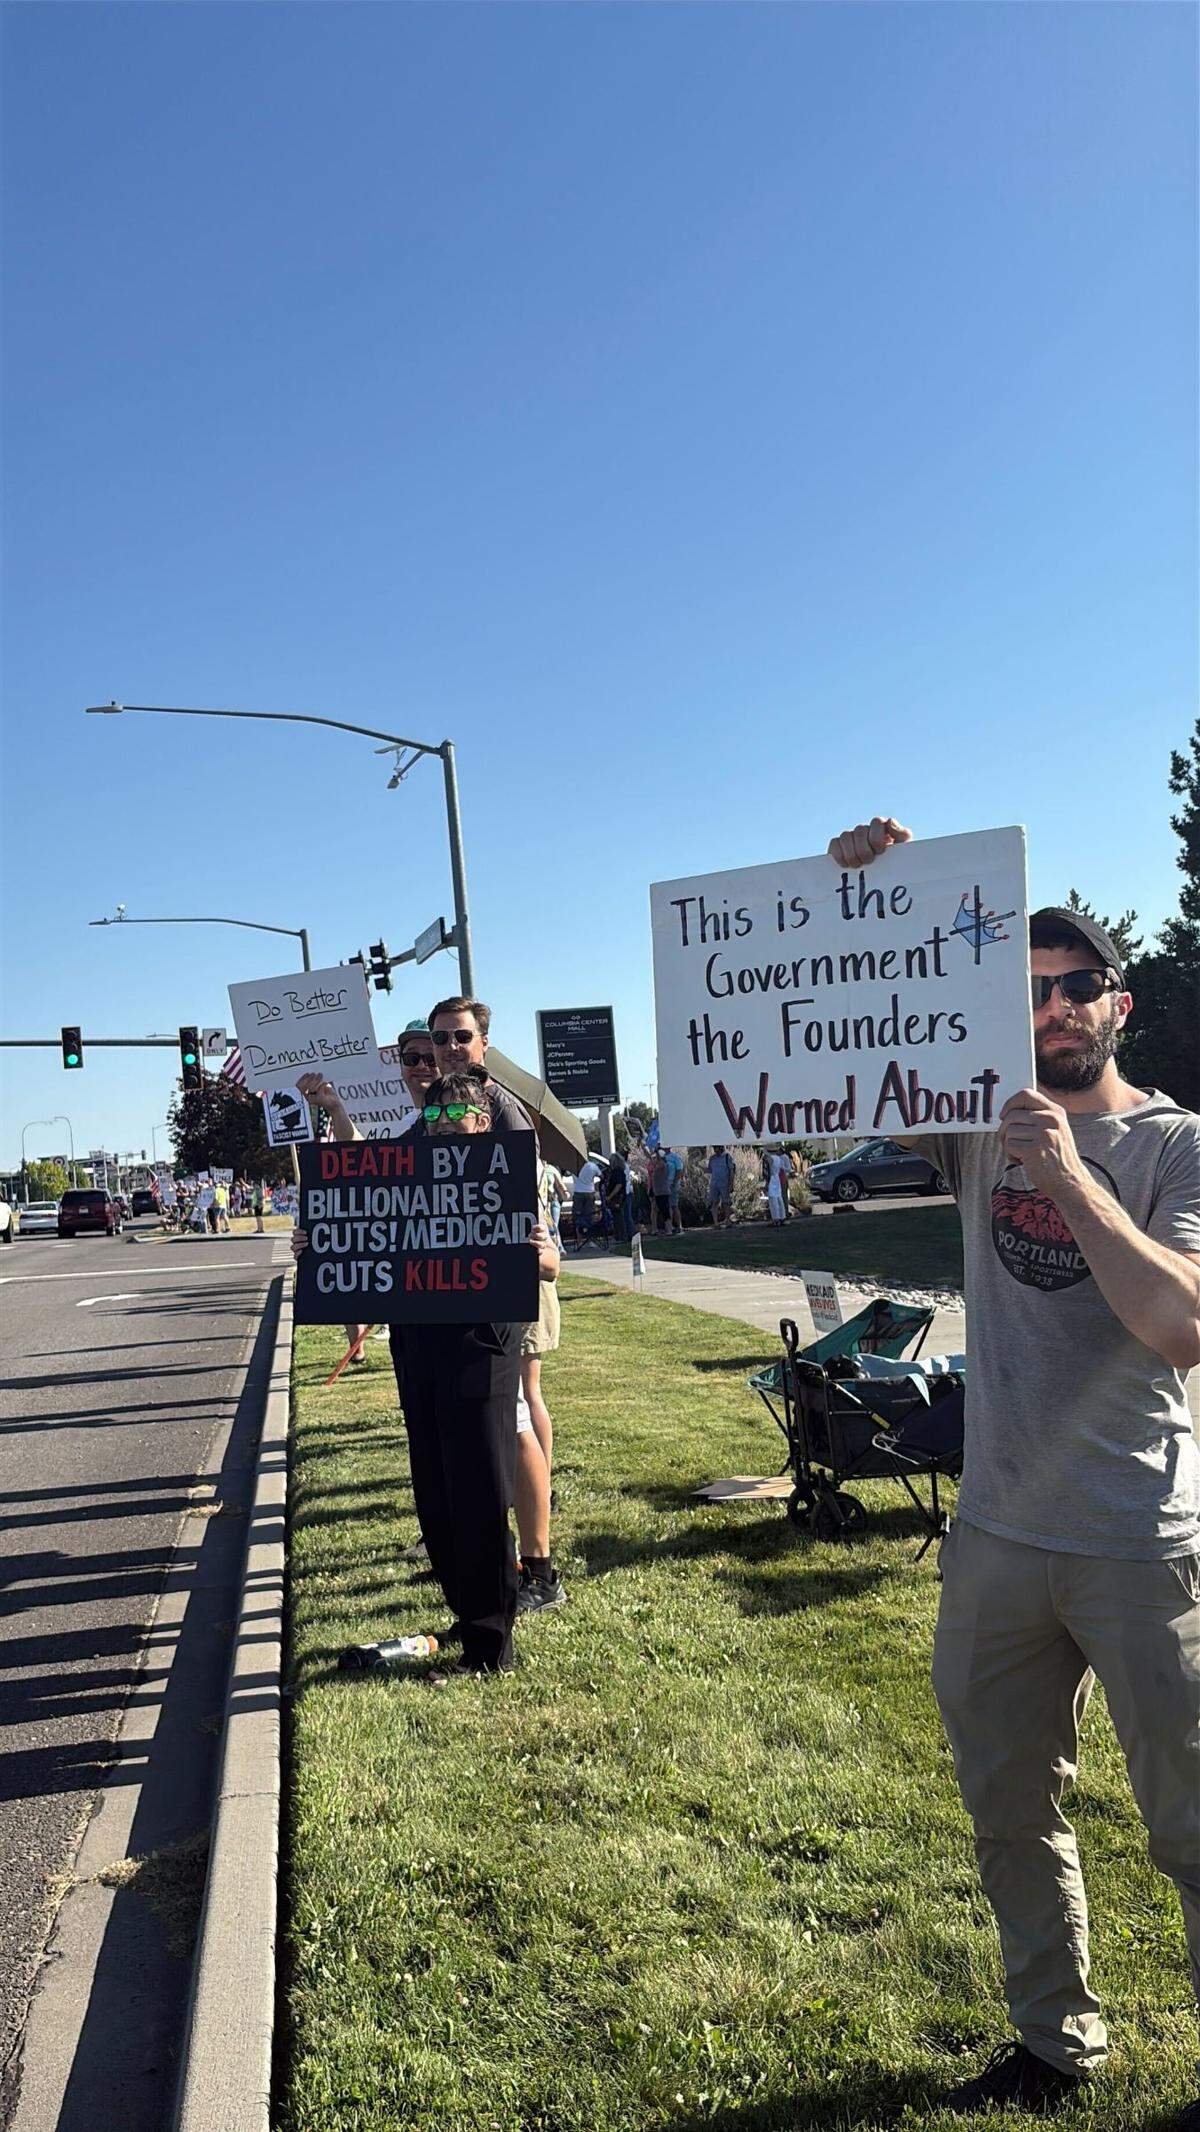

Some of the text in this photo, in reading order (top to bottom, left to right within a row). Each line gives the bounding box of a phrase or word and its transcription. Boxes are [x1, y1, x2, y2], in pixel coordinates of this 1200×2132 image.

[670, 870, 912, 946] This is the
[706, 926, 950, 998] Government
[248, 988, 348, 1021] Do Better
[581, 1018, 609, 1026] CENTER
[687, 993, 968, 1066] the Founders
[244, 1035, 369, 1069] Demand Better
[338, 1079, 407, 1100] CONVICT
[714, 1060, 1001, 1139] Warned About
[321, 1143, 510, 1180] DEATH BY A
[308, 1180, 502, 1220] BILLIONAIRES
[402, 1211, 538, 1251] MEDICAID
[998, 1230, 1088, 1270] PORTLAND
[316, 1258, 489, 1294] CUTS KILLS
